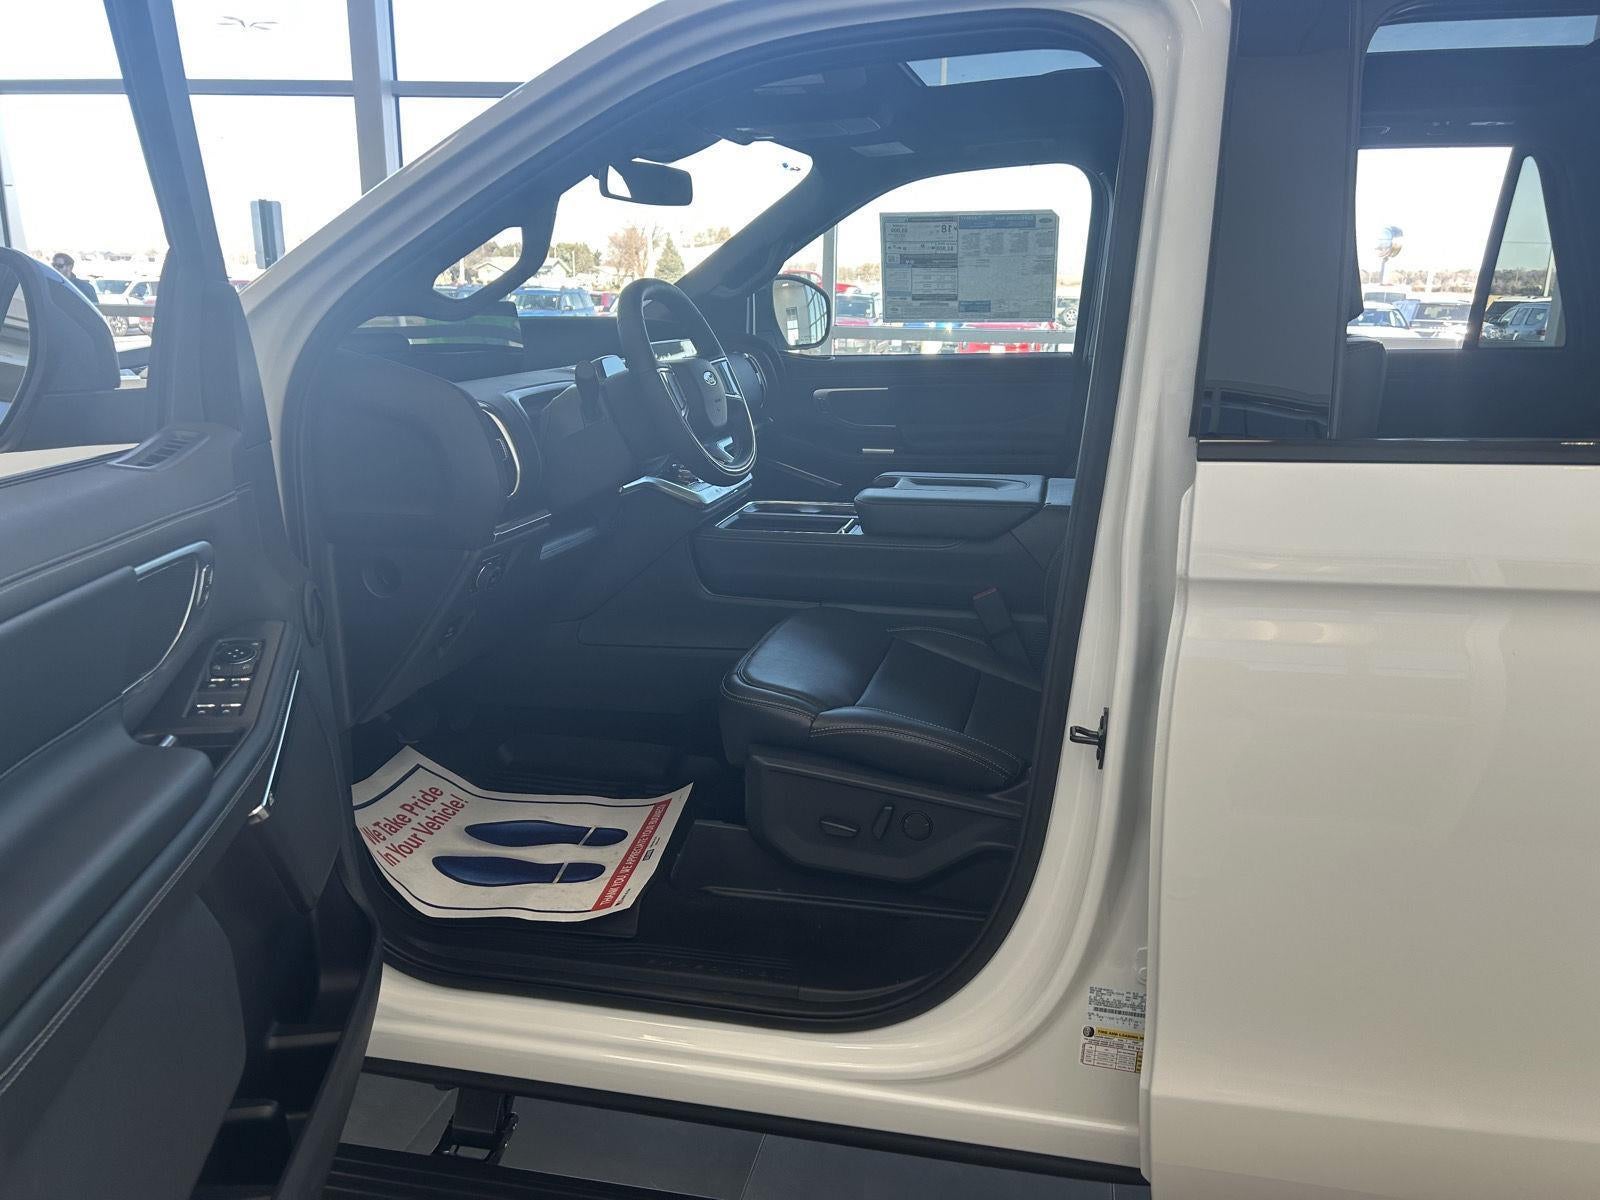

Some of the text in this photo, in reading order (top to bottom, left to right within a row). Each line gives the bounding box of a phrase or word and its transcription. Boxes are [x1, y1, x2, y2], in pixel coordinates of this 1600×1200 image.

[361, 786, 444, 846] We Take Pride
[377, 793, 469, 867] In Your Vehicle!
[626, 836, 648, 866] APPRECIATE
[621, 864, 632, 875] WE
[600, 885, 618, 906] THANK
